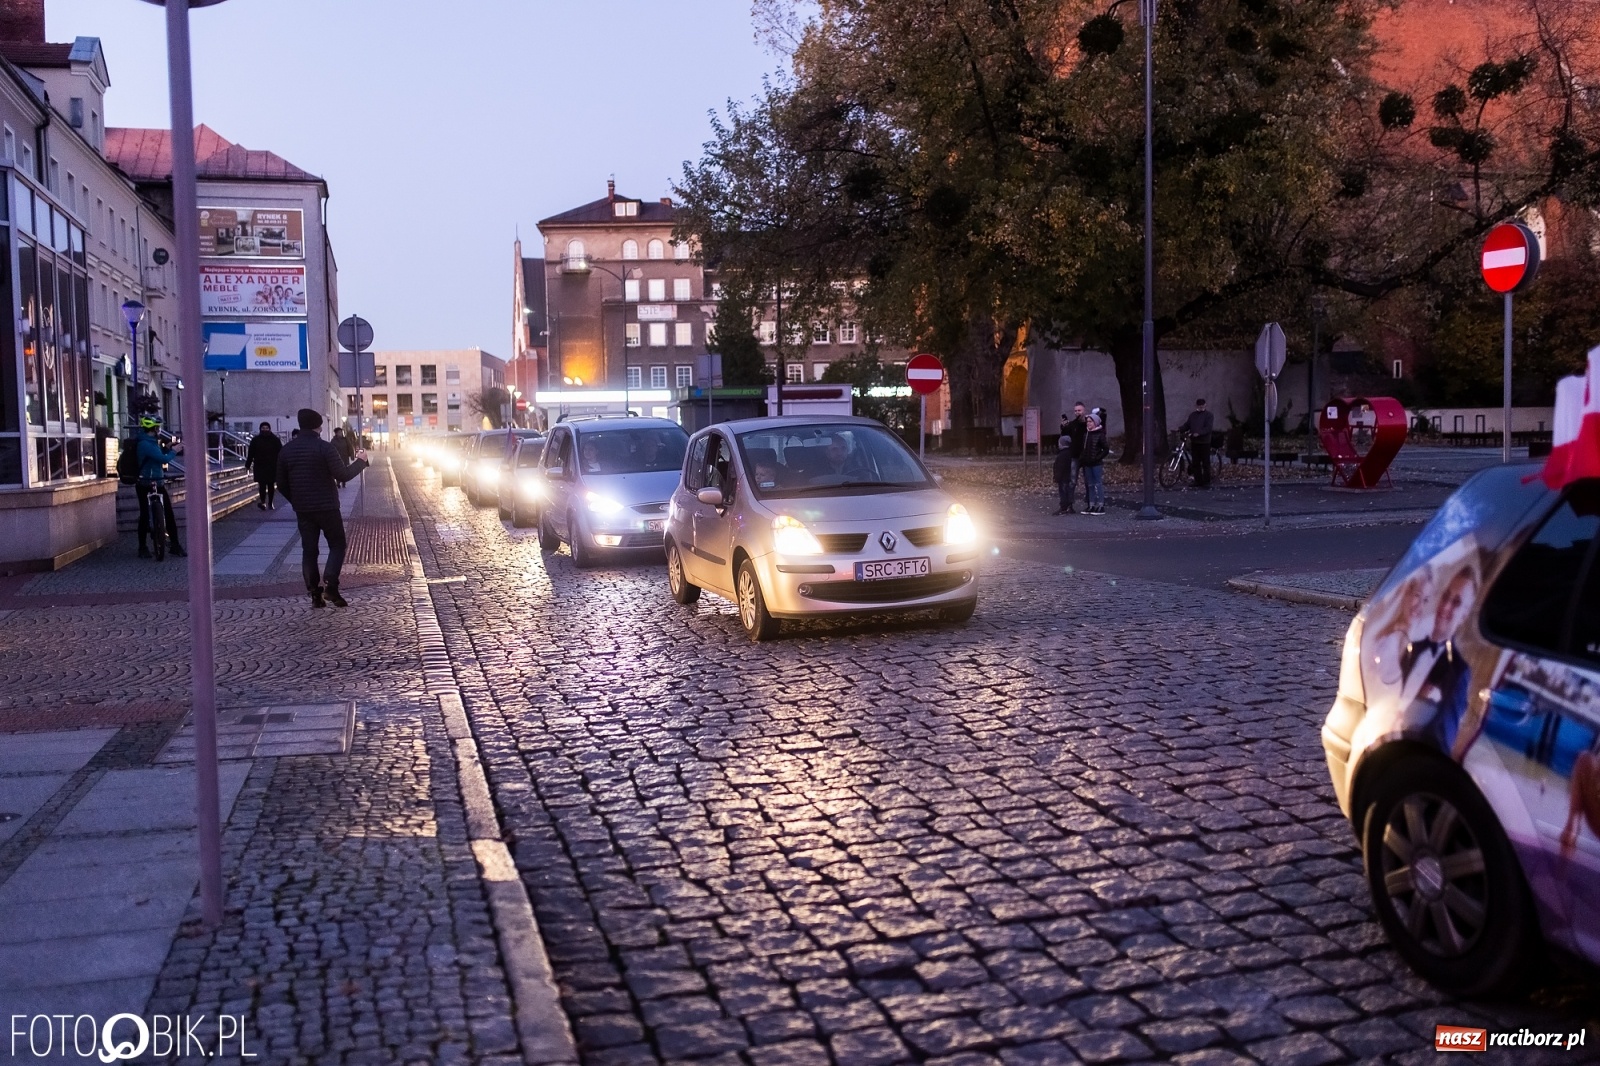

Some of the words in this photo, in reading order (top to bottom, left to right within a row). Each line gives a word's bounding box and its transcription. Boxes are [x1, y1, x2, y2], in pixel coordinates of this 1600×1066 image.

[203, 274, 300, 285] ALEXANDER
[203, 284, 238, 292] MEBLE
[865, 563, 892, 577] SRC
[897, 560, 927, 575] 3FT6
